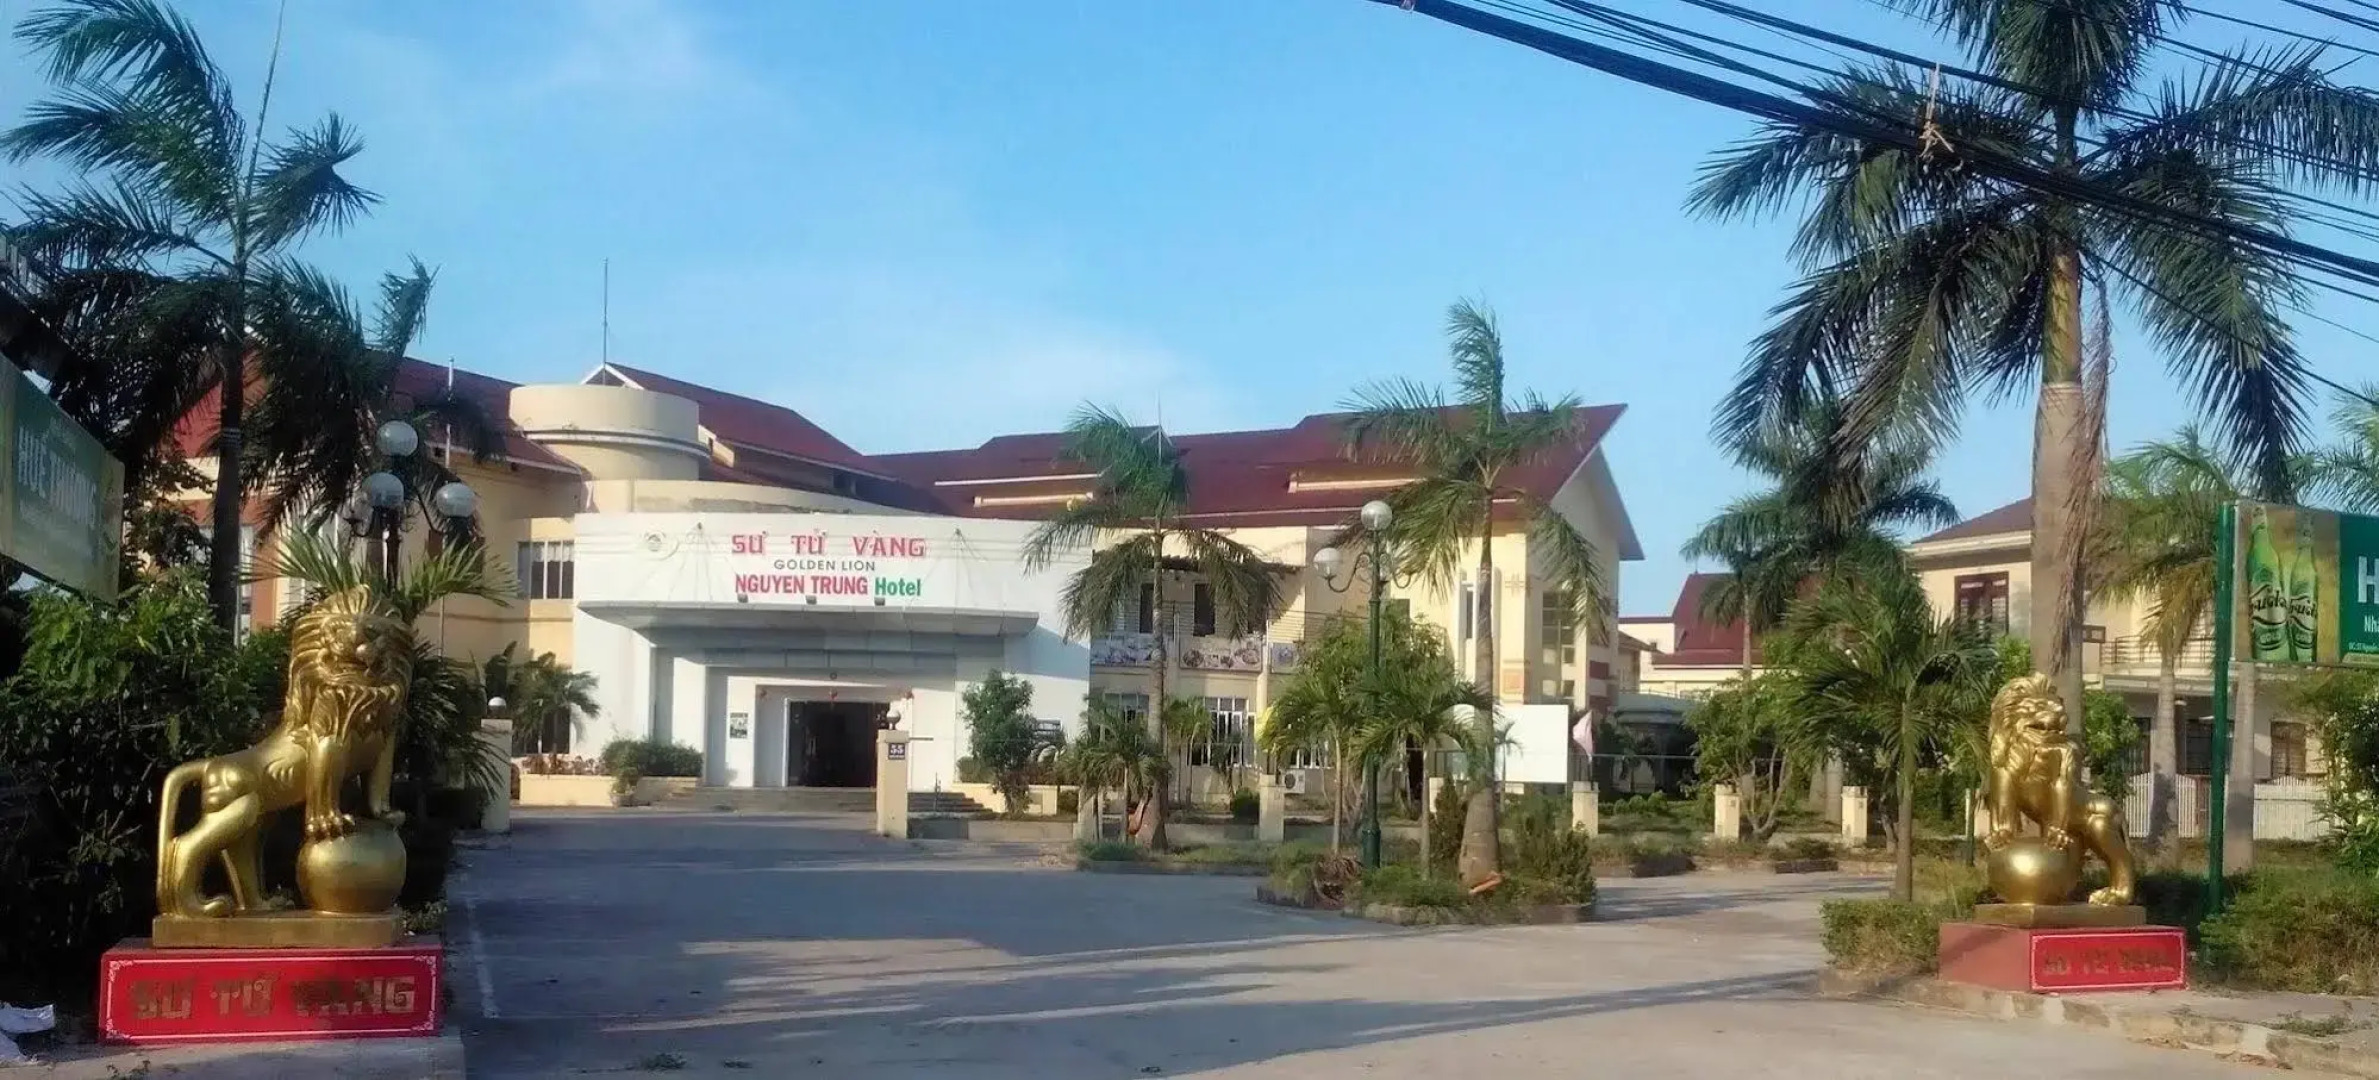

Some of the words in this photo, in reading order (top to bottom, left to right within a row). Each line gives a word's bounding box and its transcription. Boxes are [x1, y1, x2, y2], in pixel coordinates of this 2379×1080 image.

[731, 530, 768, 555] SƯ
[853, 530, 926, 557] VÀNG
[773, 558, 836, 571] GOLDEN
[841, 560, 876, 572] LION
[735, 573, 805, 594] NGUYEN
[810, 575, 869, 595] TRUNG
[874, 576, 922, 597] Hotel
